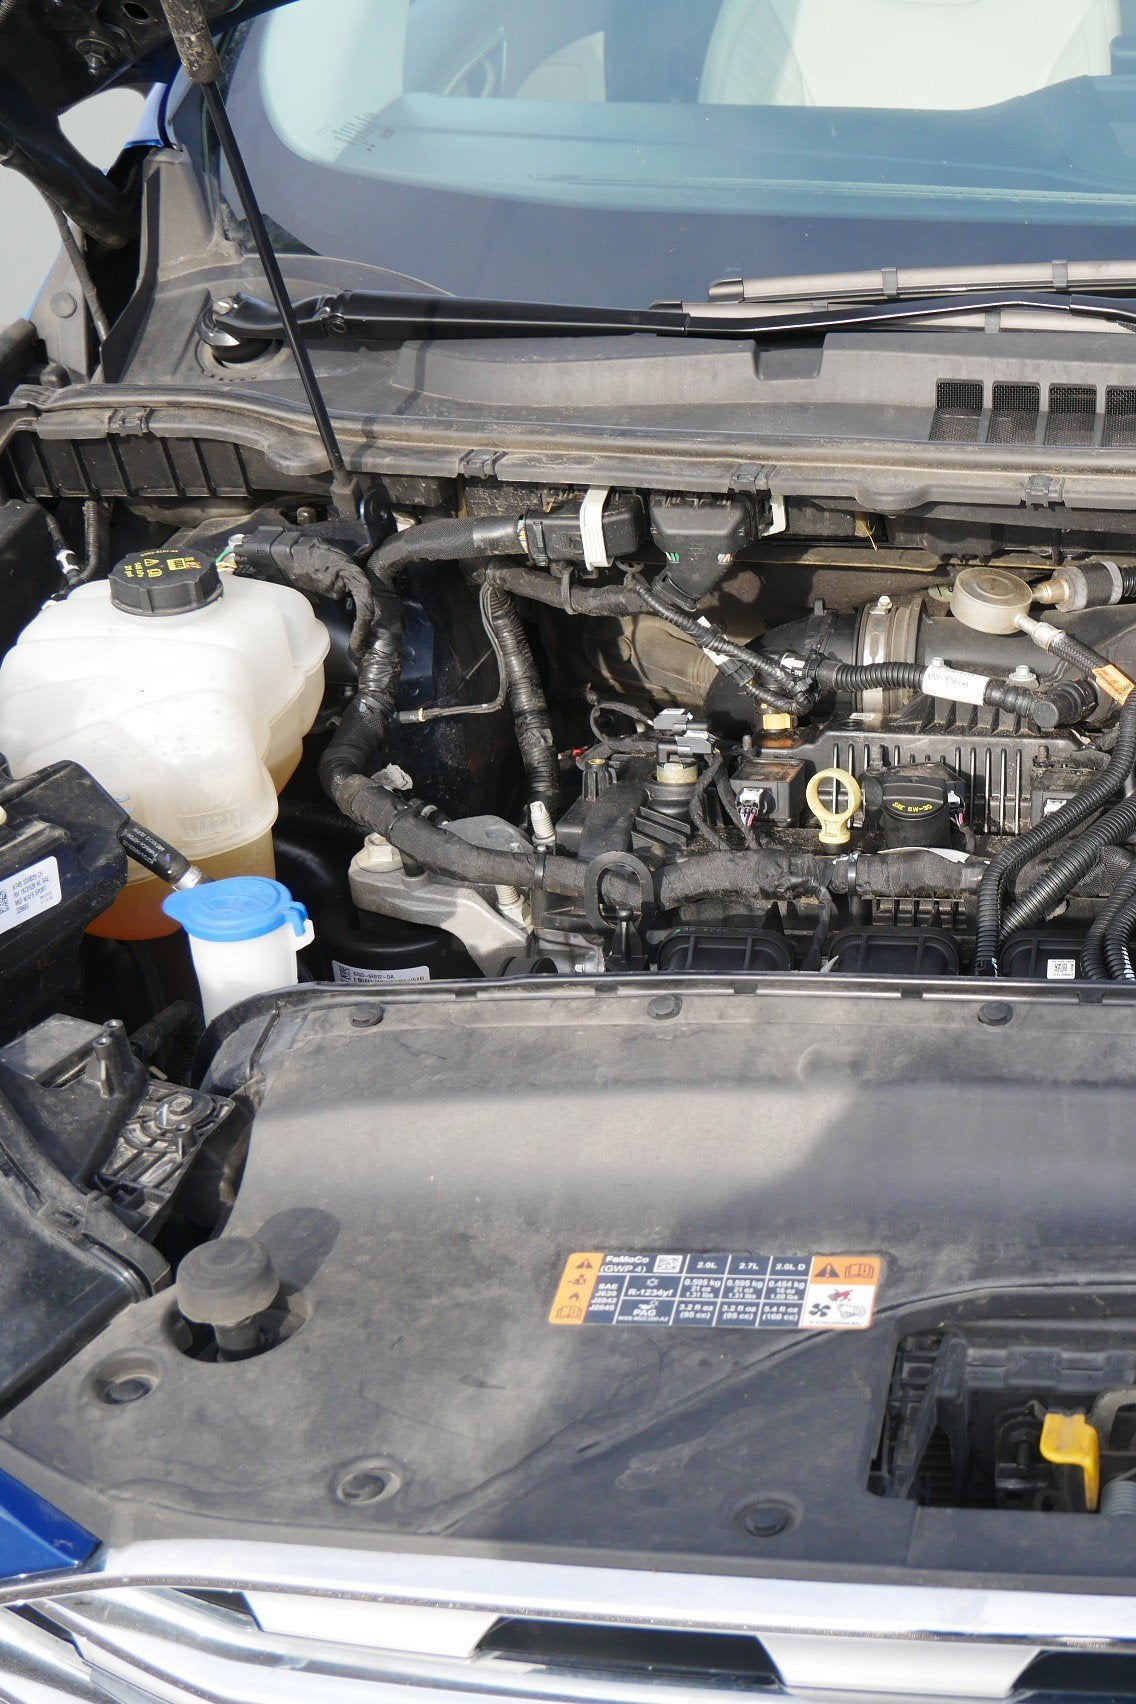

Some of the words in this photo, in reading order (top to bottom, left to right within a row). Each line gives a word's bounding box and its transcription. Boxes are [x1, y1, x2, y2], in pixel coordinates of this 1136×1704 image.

[606, 1255, 649, 1264] FoMoCo
[600, 1264, 632, 1273] (GWP
[697, 1261, 717, 1269] 2.0L
[739, 1262, 759, 1270] 2.7L
[775, 1263, 796, 1271] 2.0L
[628, 1288, 673, 1297] R-1234yf
[633, 1309, 656, 1317] PAG
